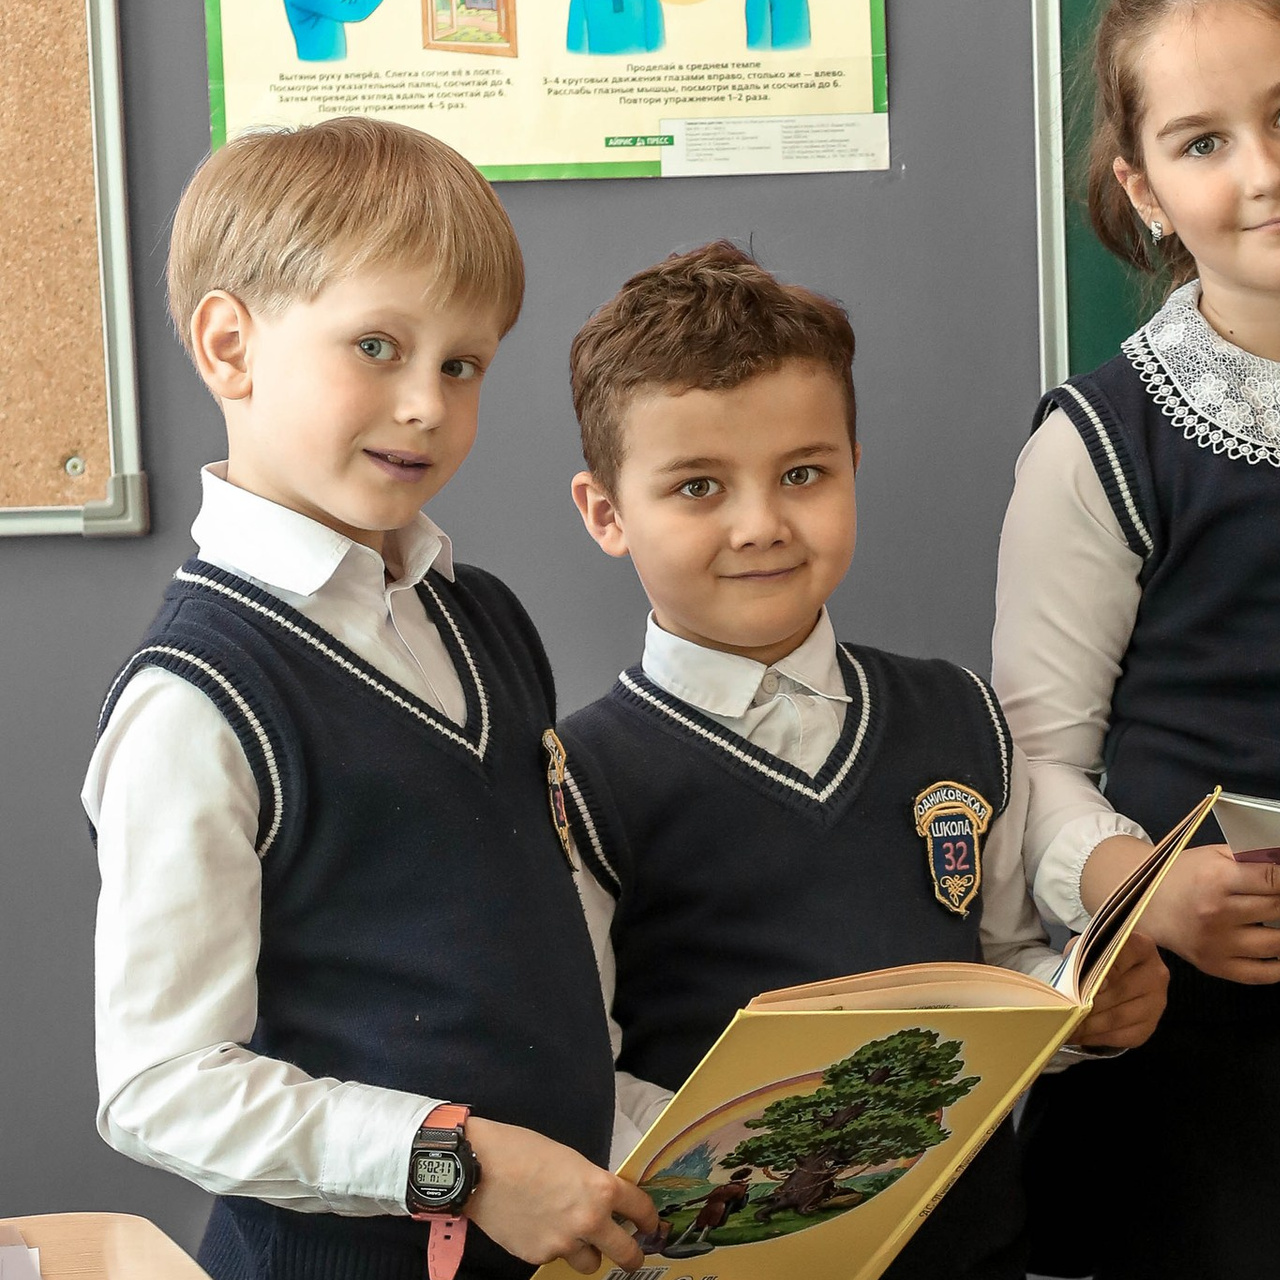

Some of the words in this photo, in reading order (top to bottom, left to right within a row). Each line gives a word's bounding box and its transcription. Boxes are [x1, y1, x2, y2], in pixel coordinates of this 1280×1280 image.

[608, 136, 633, 146] АЙРИС
[646, 136, 670, 145] ПРЕСС
[917, 788, 987, 819] ОДНИКОВСКАЯ
[931, 820, 973, 837] ШКОЛА
[942, 841, 970, 871] 32
